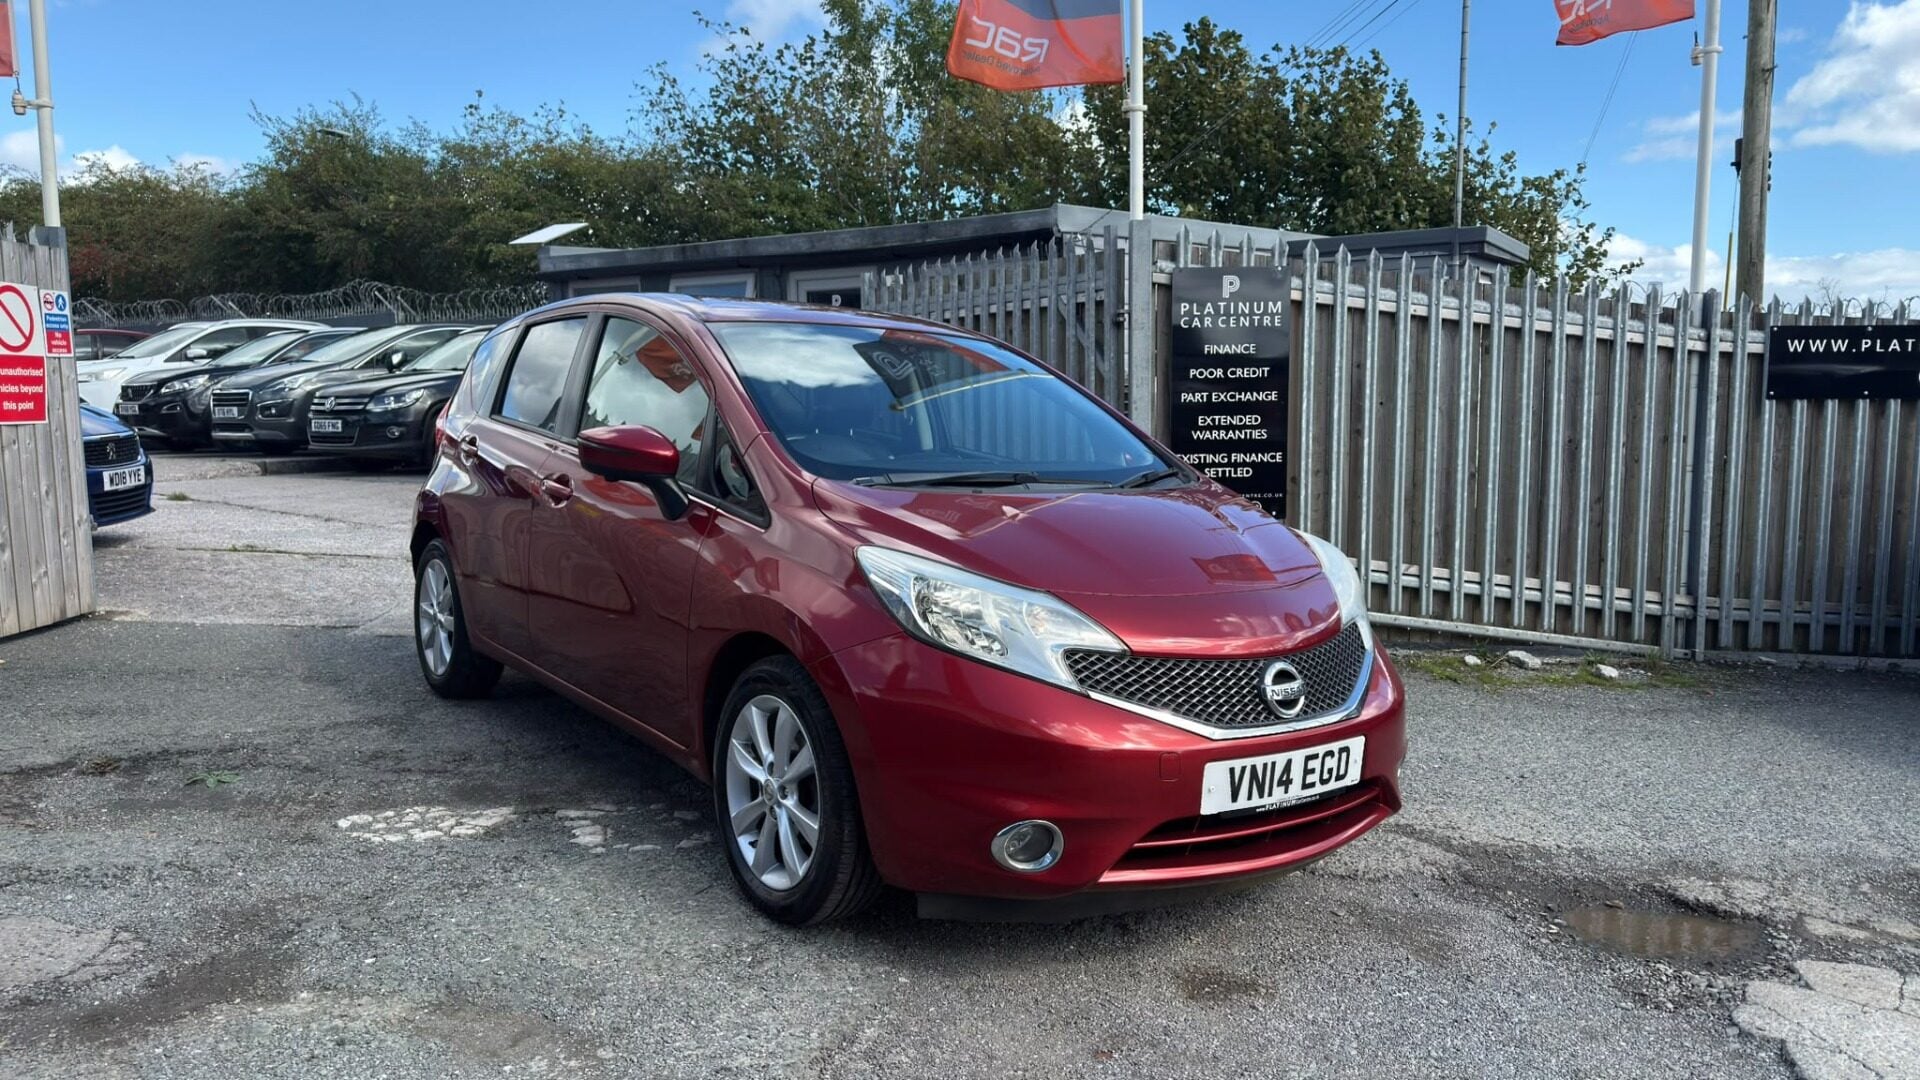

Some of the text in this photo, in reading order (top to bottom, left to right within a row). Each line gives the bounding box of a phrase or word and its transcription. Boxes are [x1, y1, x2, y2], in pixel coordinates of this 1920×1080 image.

[1180, 301, 1283, 316] PLATINUM
[1180, 315, 1282, 329] CAR CENTRE
[1203, 344, 1257, 355] FINANCE
[0, 367, 44, 376] unauthorised
[1189, 367, 1270, 379] POOR CREDIT
[20, 383, 43, 395] beyond
[1180, 391, 1278, 403] PART EXCHANGE
[3, 400, 34, 412] this point
[1197, 415, 1261, 426] EXTENDED
[1191, 429, 1268, 440] WARRANTIES
[1231, 452, 1283, 463] FINANCE
[108, 468, 142, 487] WD18 YYE
[1204, 467, 1253, 478] SETTLED
[1229, 746, 1351, 804] VN14 EGD
